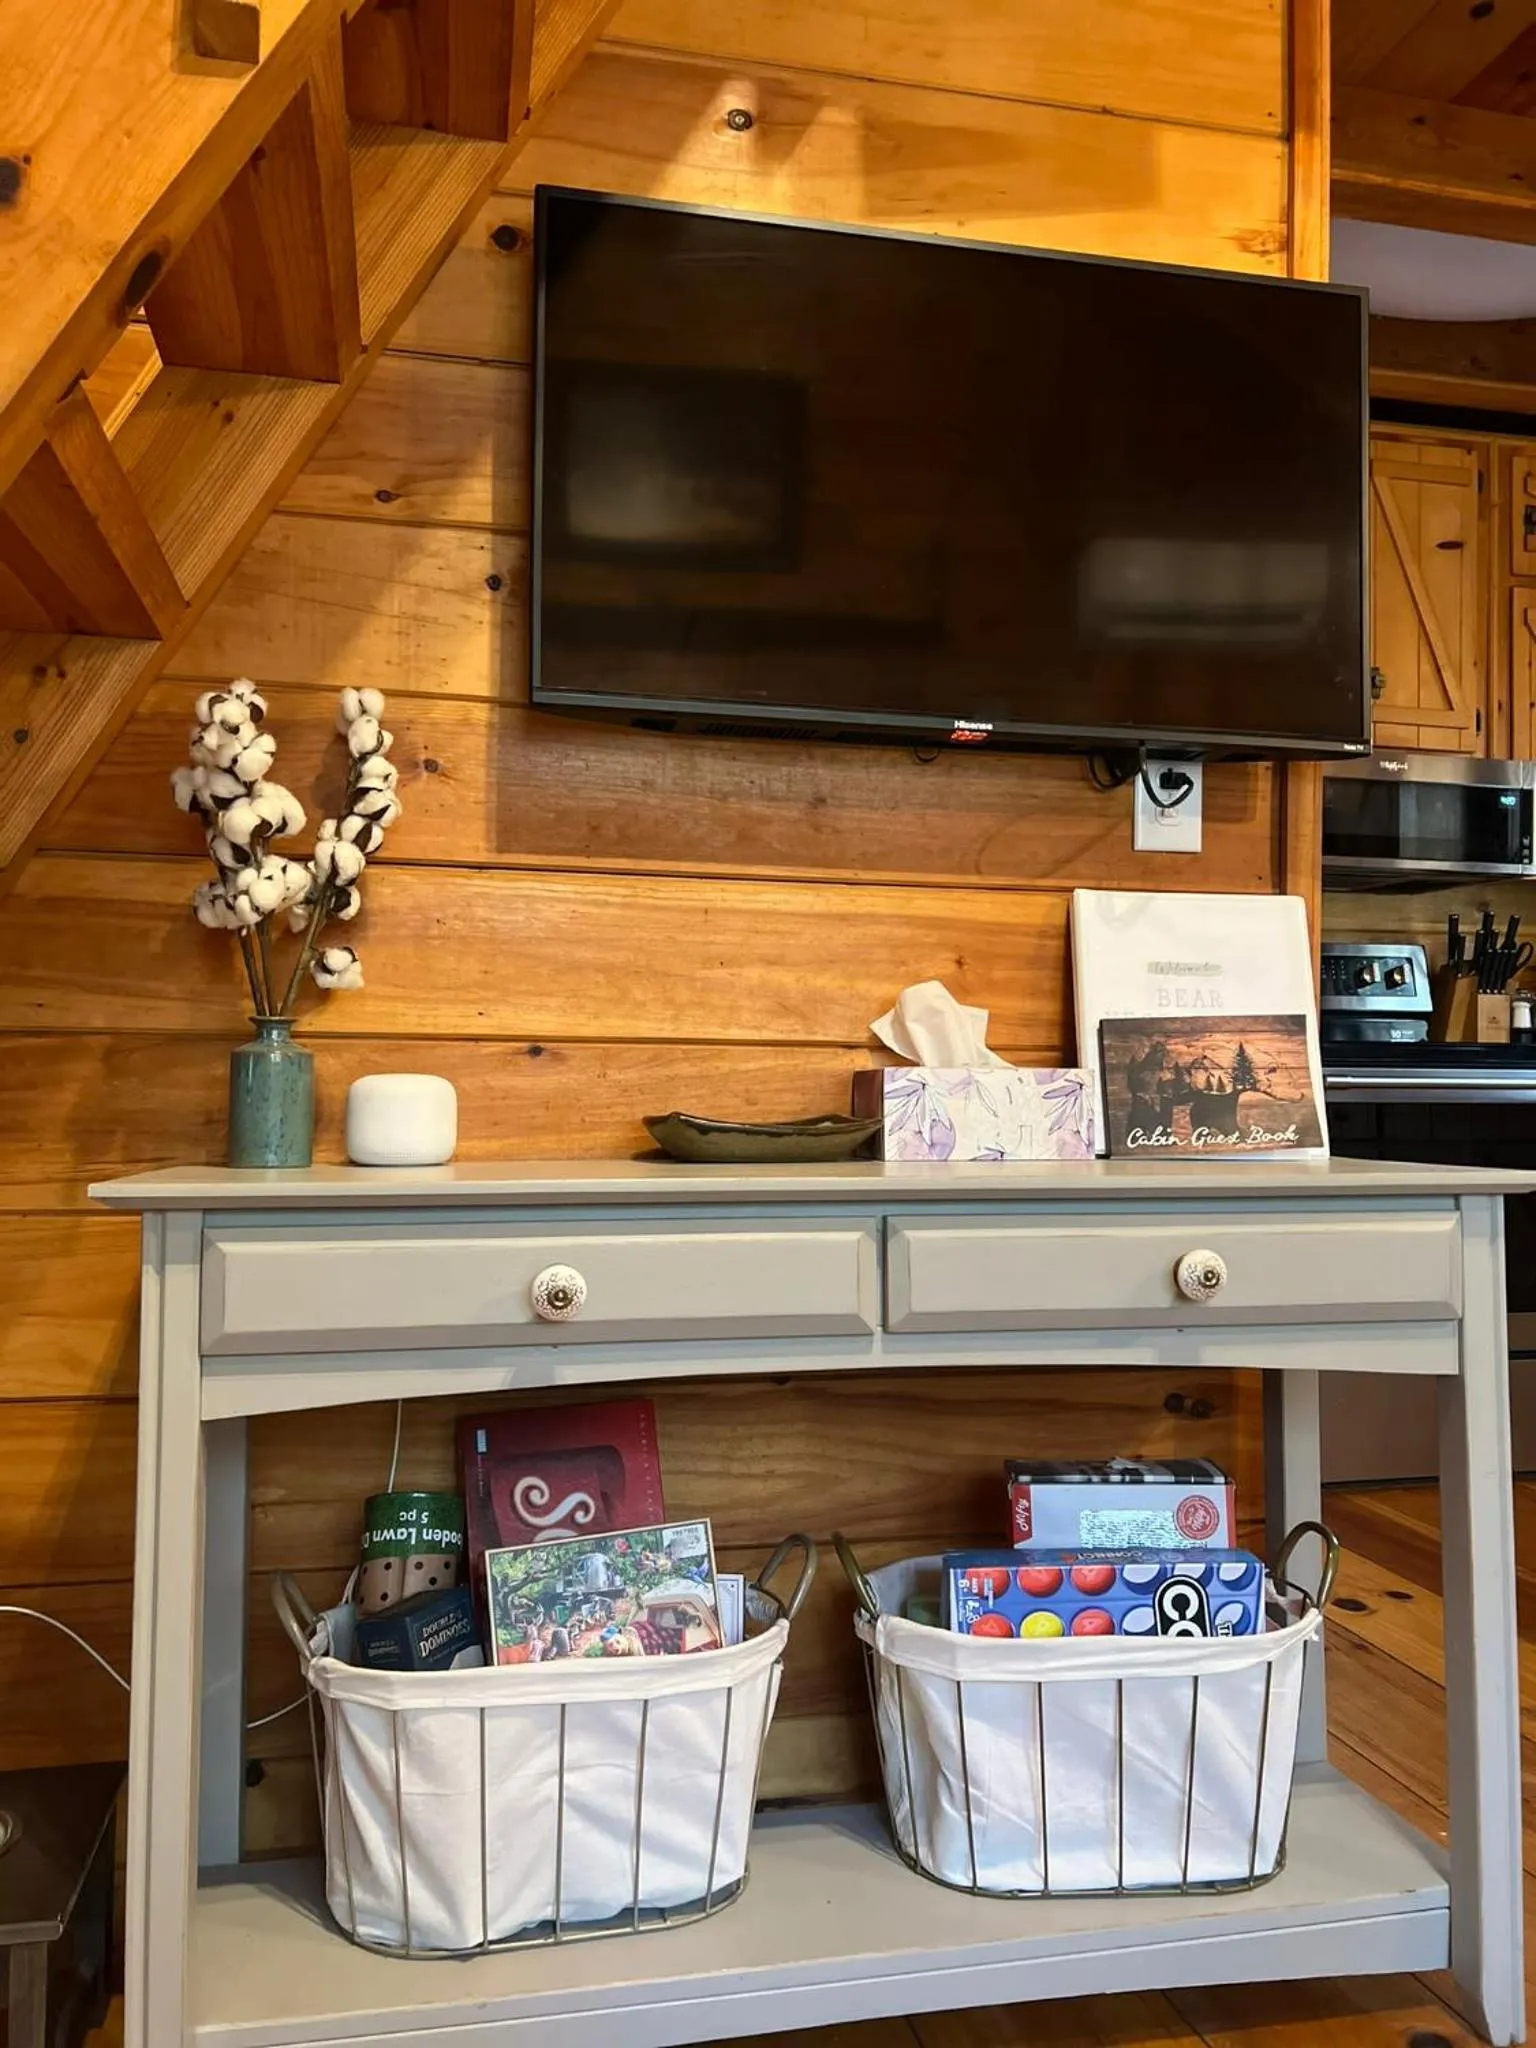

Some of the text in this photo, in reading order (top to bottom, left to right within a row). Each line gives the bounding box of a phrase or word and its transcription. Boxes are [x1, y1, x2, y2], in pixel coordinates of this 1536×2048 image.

[954, 720, 993, 730] Hisense
[1156, 987, 1224, 1008] BEAR
[1126, 1124, 1299, 1148] Cabin Guest Book
[399, 1508, 429, 1524] 5 pc
[372, 1527, 417, 1545] Lawn
